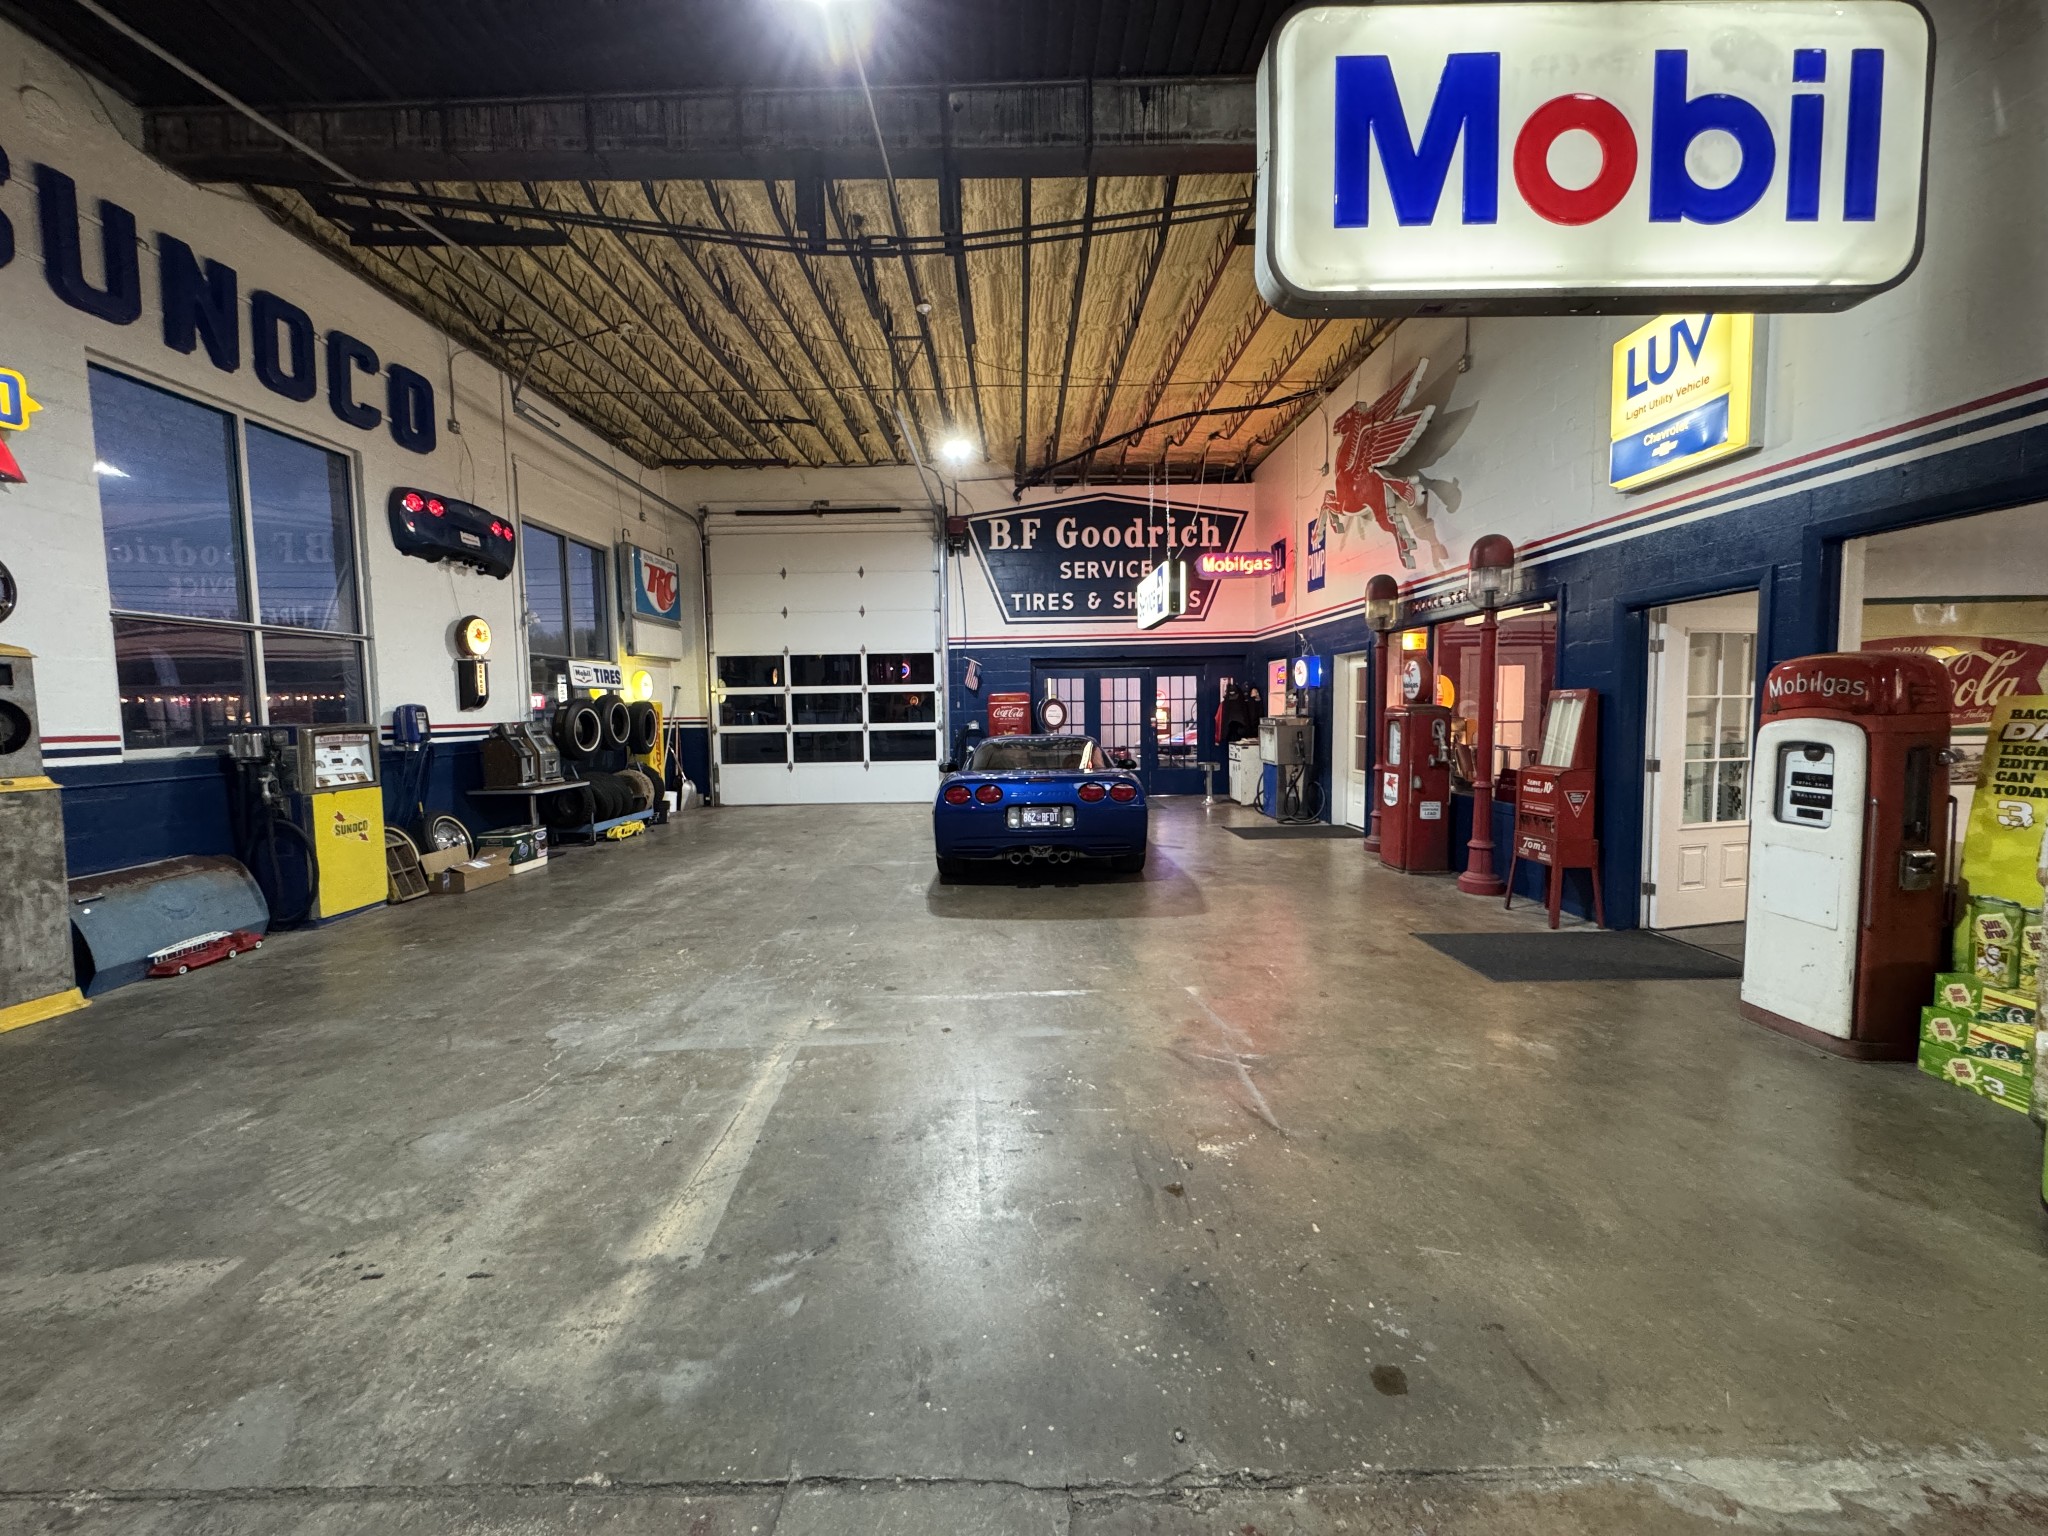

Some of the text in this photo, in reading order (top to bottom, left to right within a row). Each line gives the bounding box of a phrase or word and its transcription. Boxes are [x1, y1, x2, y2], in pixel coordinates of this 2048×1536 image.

[1334, 48, 1884, 228] Mobil
[1627, 313, 1714, 401] LUV
[1626, 375, 1710, 421] Light Utility Vehicle
[1643, 419, 1689, 446] Chevrolet
[987, 517, 1221, 550] B.F Goodrich
[1060, 560, 1152, 580] SERVICE
[1202, 556, 1273, 575] Mobilgas
[1308, 549, 1325, 581] PUMP
[643, 562, 677, 611] RC
[1011, 590, 1201, 611] TIRES & SHS
[574, 668, 621, 685] Mobil TIRES
[1768, 670, 1867, 698] Mobilgas
[993, 707, 1024, 718] Coca-Cola
[2010, 709, 2048, 720] BAC
[1999, 722, 2048, 742] DA
[2001, 745, 2048, 756] LEGA
[1995, 771, 2036, 783] CAN
[1023, 812, 1037, 823] 862
[1997, 800, 2034, 827] 3
[335, 820, 368, 836] SUNOCO
[1523, 836, 1547, 852] Tom's
[1984, 929, 2008, 939] drop
[1983, 1075, 2006, 1097] 3
